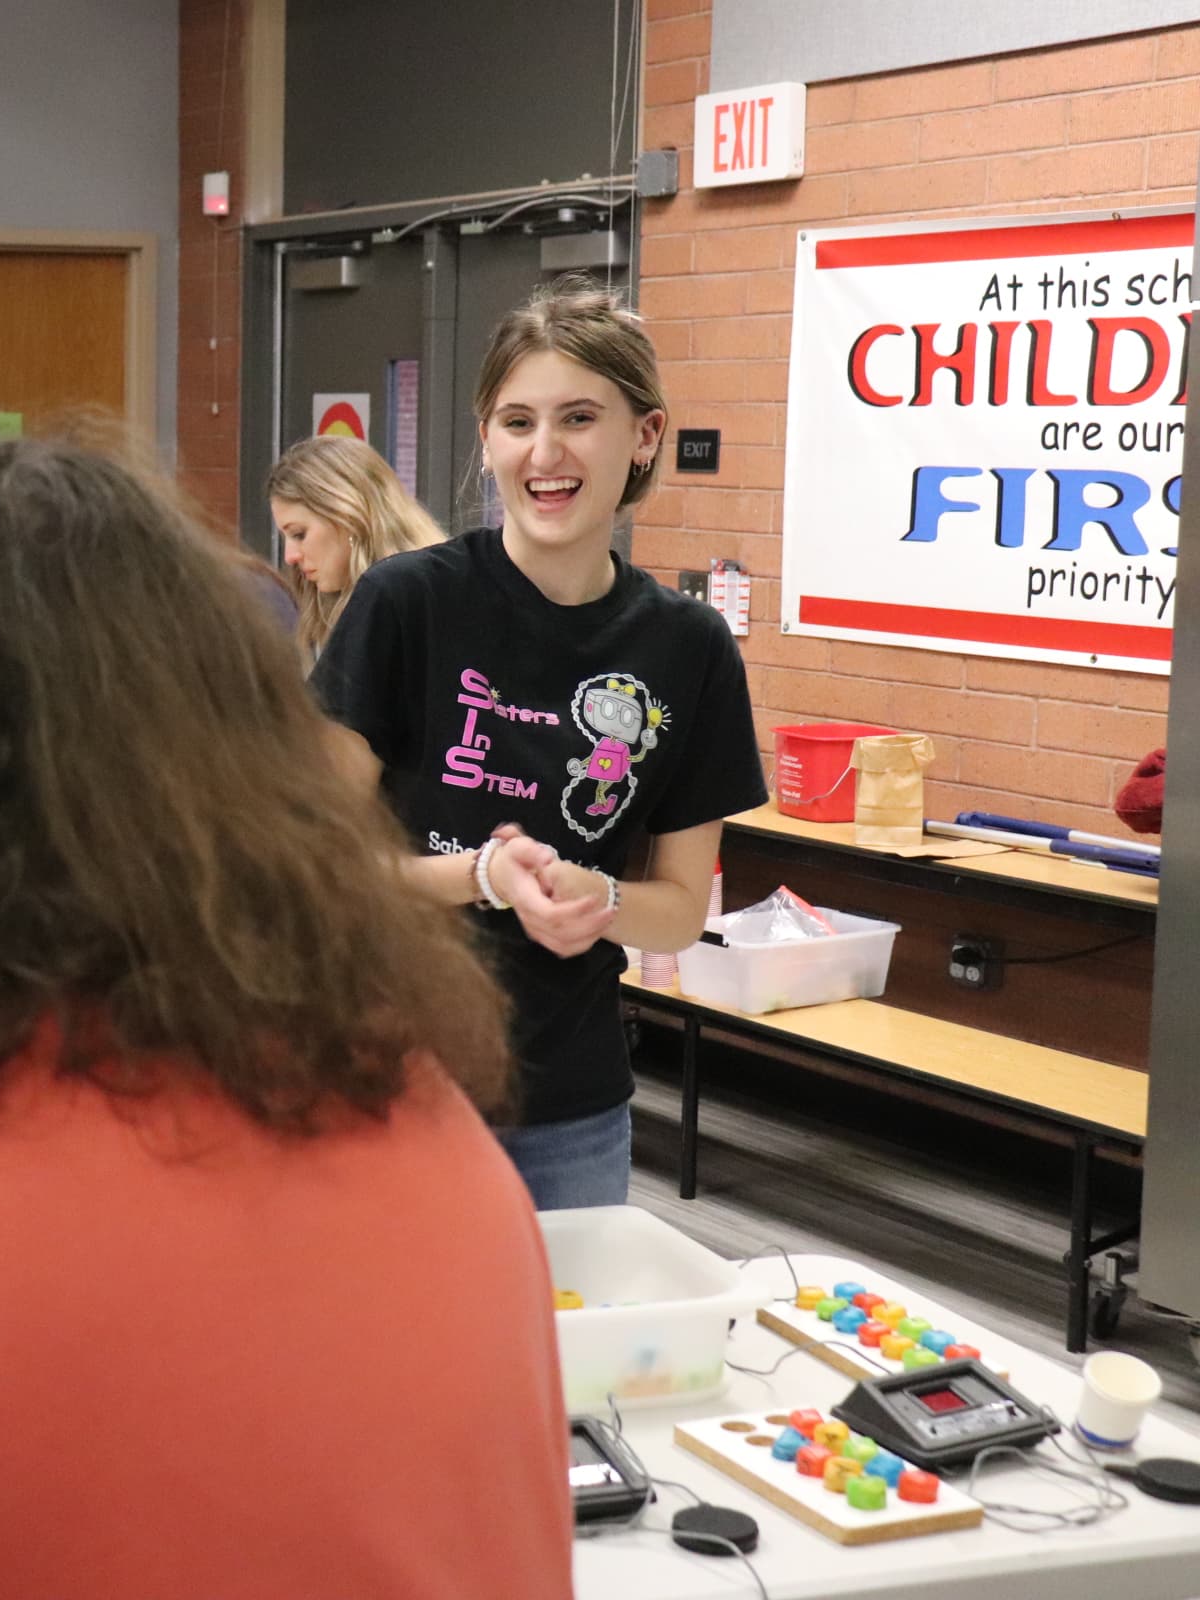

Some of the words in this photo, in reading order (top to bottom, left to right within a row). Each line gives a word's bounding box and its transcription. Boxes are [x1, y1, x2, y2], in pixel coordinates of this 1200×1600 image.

[713, 96, 774, 173] EXIT
[979, 273, 1023, 311] At
[1038, 261, 1110, 310] this
[683, 441, 712, 458] EXIT
[1041, 421, 1103, 452] are
[1118, 421, 1184, 453] our
[1027, 562, 1176, 619] priority
[458, 668, 560, 726] Sisters
[461, 707, 491, 751] In
[441, 744, 538, 800] STEM
